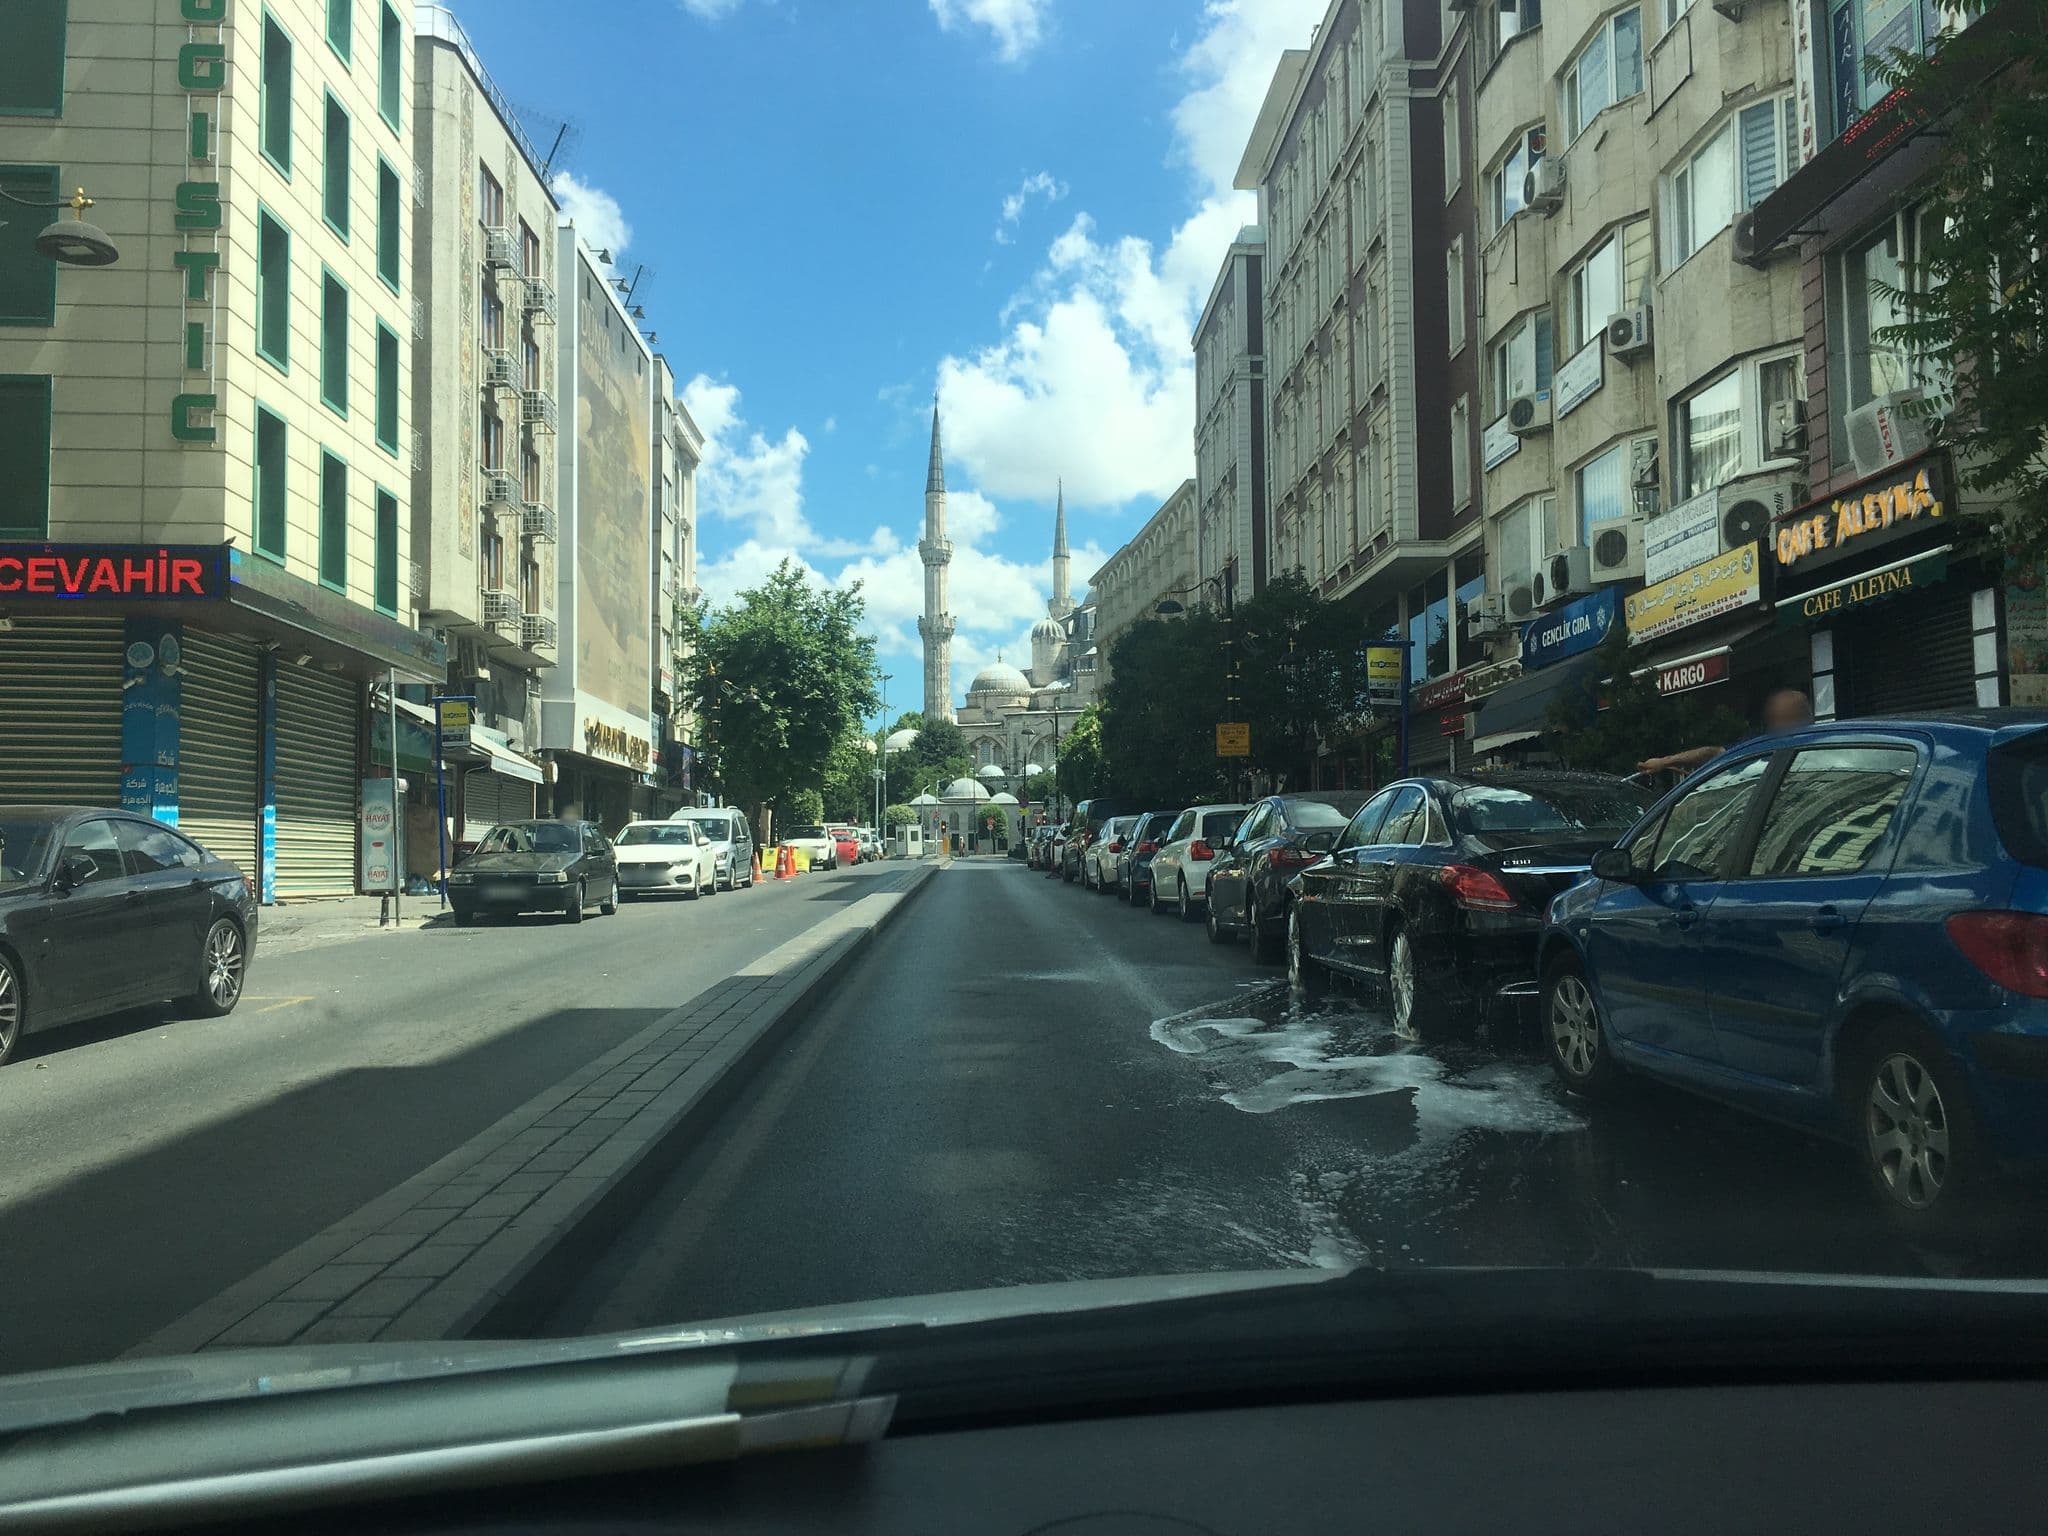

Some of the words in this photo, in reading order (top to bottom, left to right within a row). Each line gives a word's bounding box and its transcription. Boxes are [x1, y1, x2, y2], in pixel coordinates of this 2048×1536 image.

[1777, 514, 1831, 566] CAFE
[1836, 469, 1936, 548] ALEYNA
[0, 549, 204, 595] CEVAHİR
[1804, 590, 1842, 617] CAFE
[1848, 566, 1913, 604] ALEYNA
[1541, 619, 1571, 648] GENÇLİK
[1572, 614, 1591, 636] GIDA
[1664, 662, 1705, 692] KARGO
[365, 814, 391, 823] HAYAT
